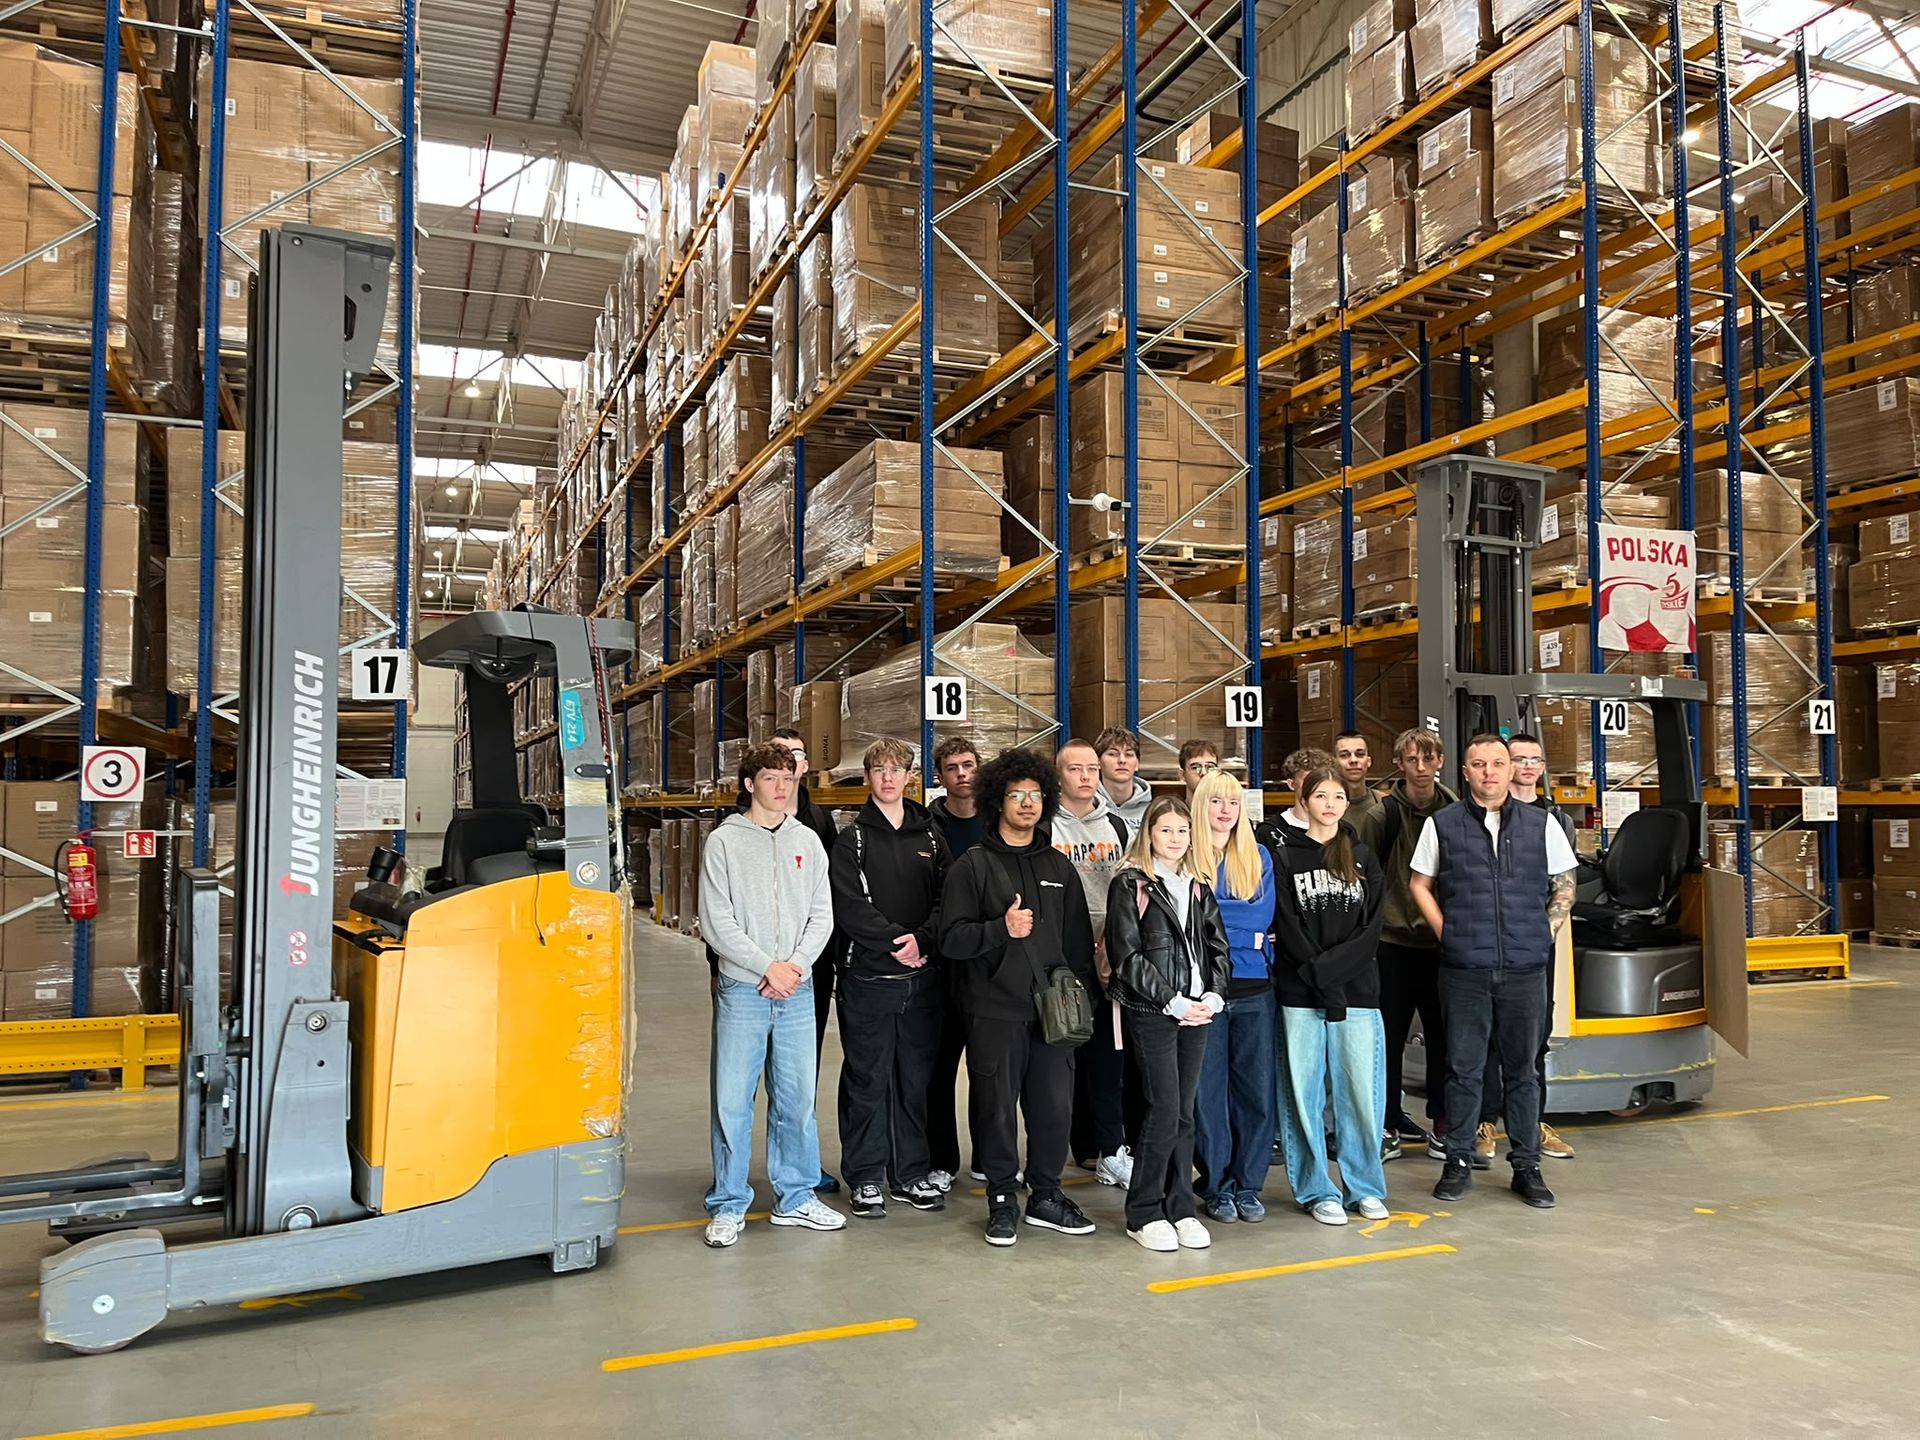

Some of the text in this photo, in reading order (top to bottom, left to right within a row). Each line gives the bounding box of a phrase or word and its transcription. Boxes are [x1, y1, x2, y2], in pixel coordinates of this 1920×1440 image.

[1606, 537, 1688, 568] POLSKA
[363, 656, 399, 693] 17
[931, 682, 962, 715] 18
[1231, 691, 1258, 722] 19
[1603, 703, 1626, 731] 20
[1814, 704, 1831, 730] 21
[101, 759, 122, 788] 3
[290, 649, 325, 897] JUNGHEINRICH
